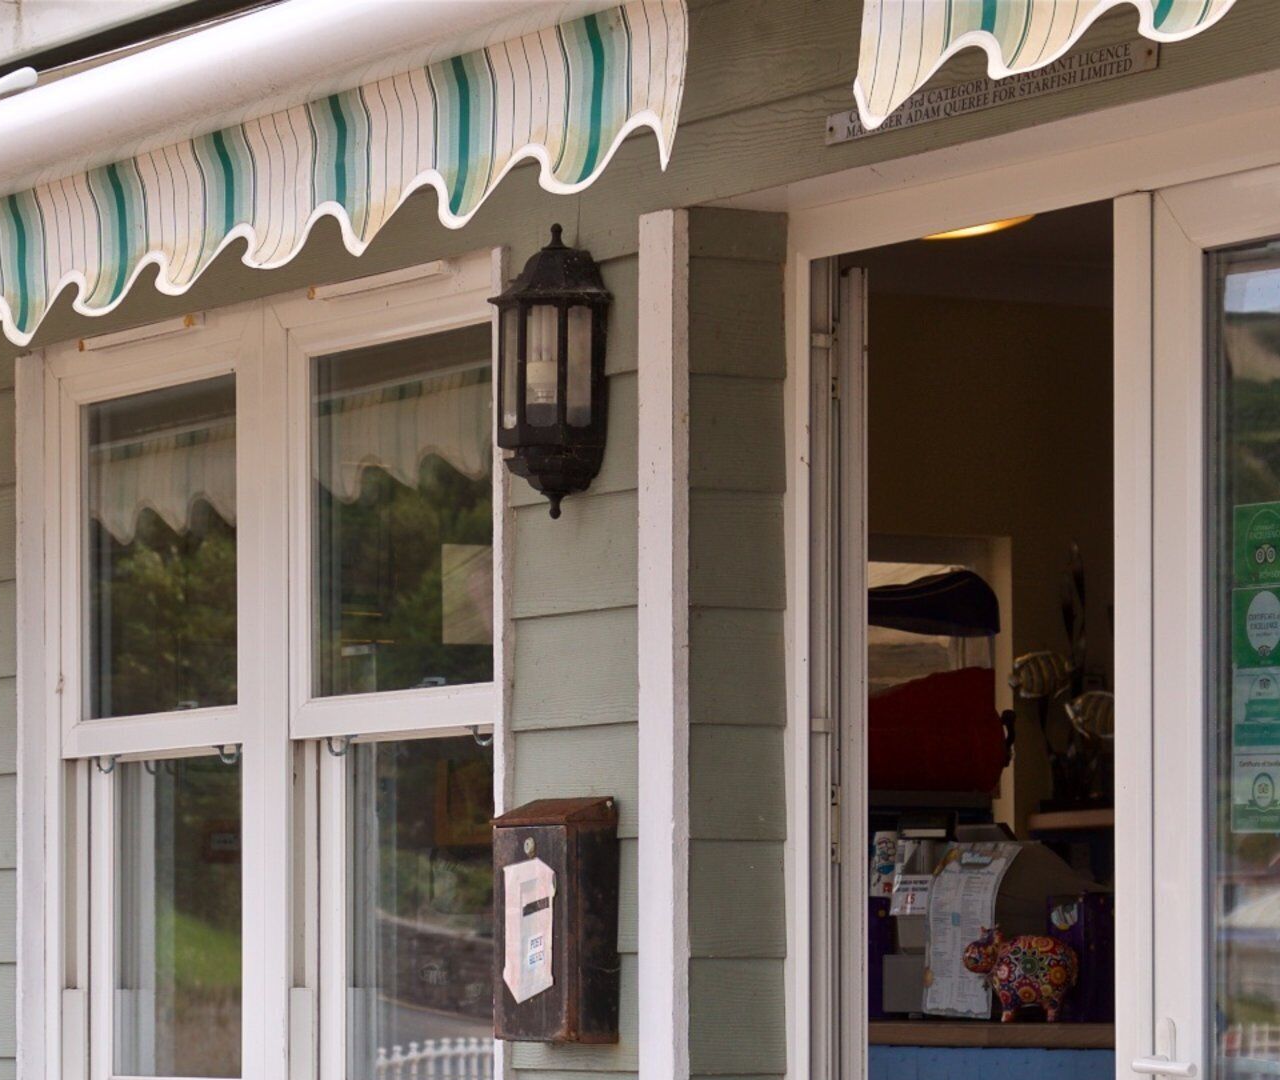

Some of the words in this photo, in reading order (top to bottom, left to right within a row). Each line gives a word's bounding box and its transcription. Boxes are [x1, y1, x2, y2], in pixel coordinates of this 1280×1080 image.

[846, 114, 903, 139] MAGER
[905, 104, 940, 124] ADAM
[943, 95, 990, 117] QUEREE
[992, 87, 1015, 104] FOR
[1019, 70, 1077, 96] STARFISH
[1080, 58, 1133, 81] LIMITED
[927, 79, 990, 105] CATEGORY
[1078, 43, 1131, 68] LICENCE
